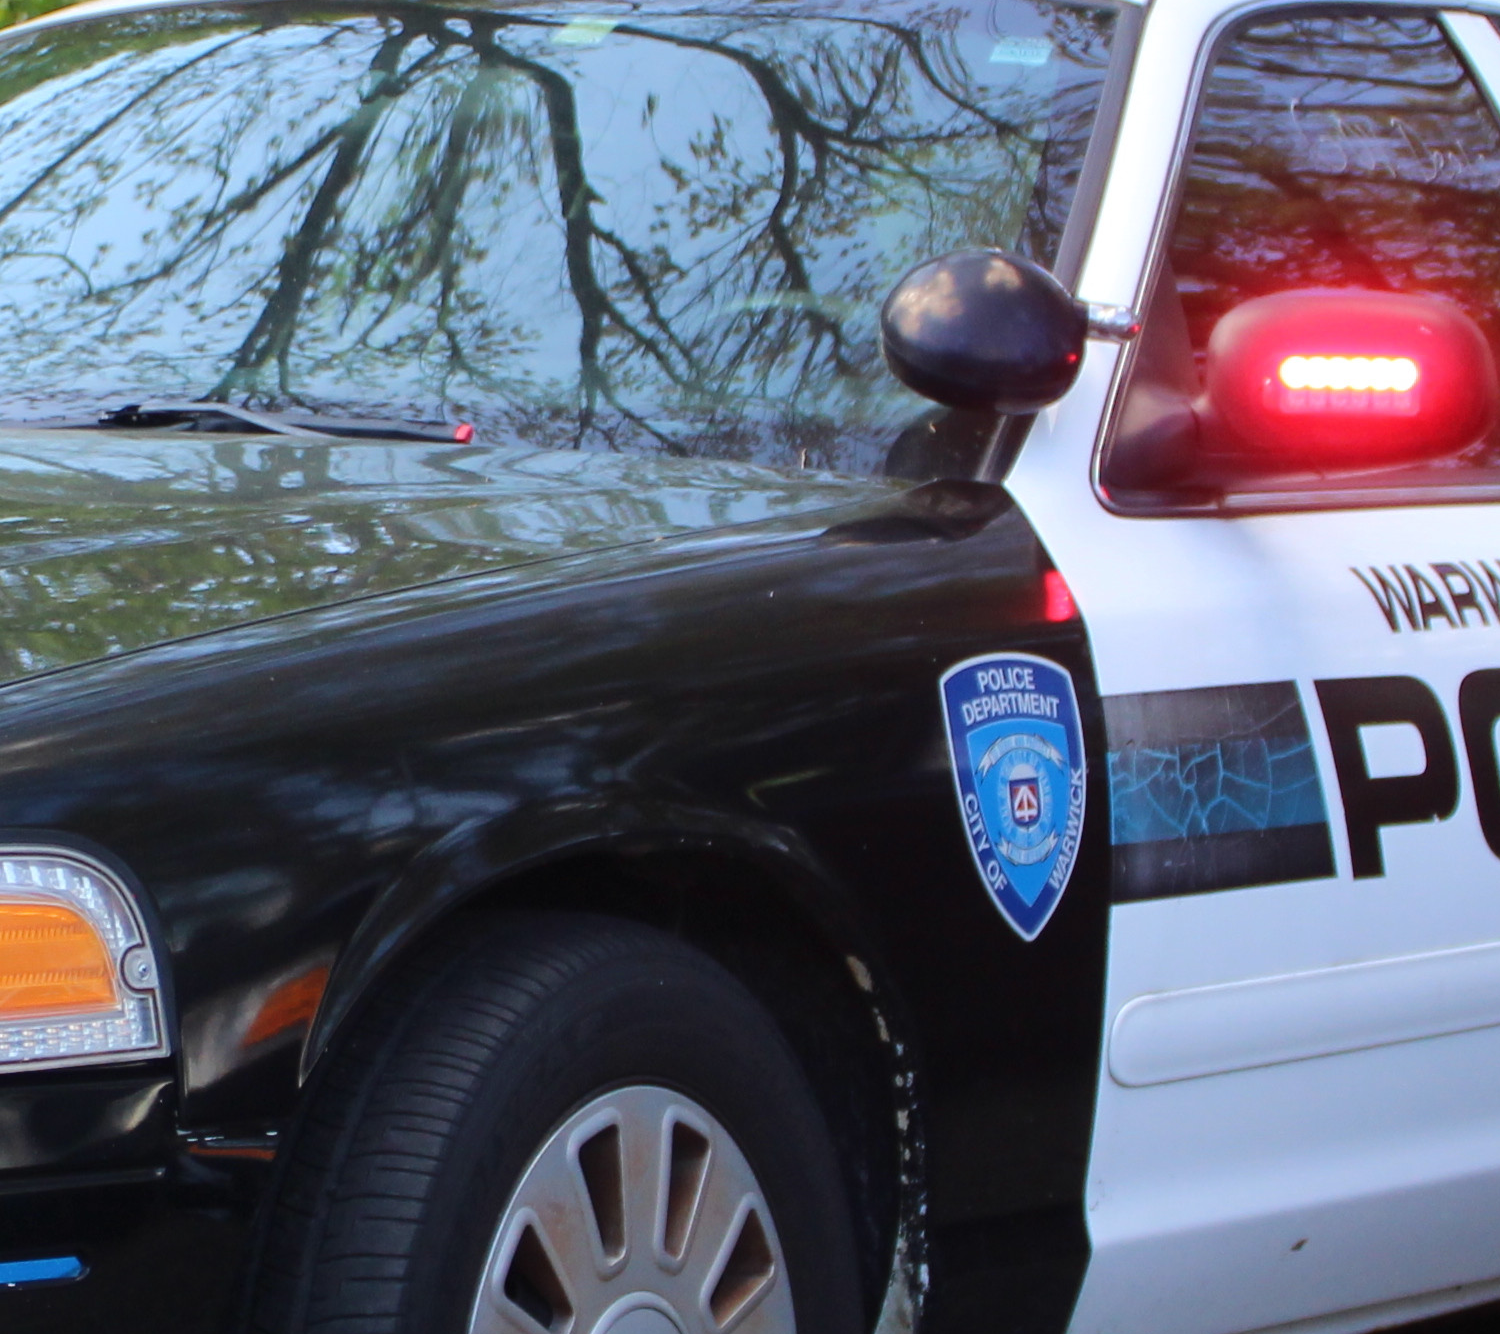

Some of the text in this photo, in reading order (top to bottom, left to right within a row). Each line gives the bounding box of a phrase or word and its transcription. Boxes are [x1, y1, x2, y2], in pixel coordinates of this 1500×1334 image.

[977, 667, 1036, 692] POLICE
[962, 695, 1060, 725] DEPARTMENT
[965, 792, 988, 852] CITY
[987, 859, 1008, 892] OF
[1048, 766, 1086, 891] WARWICK
